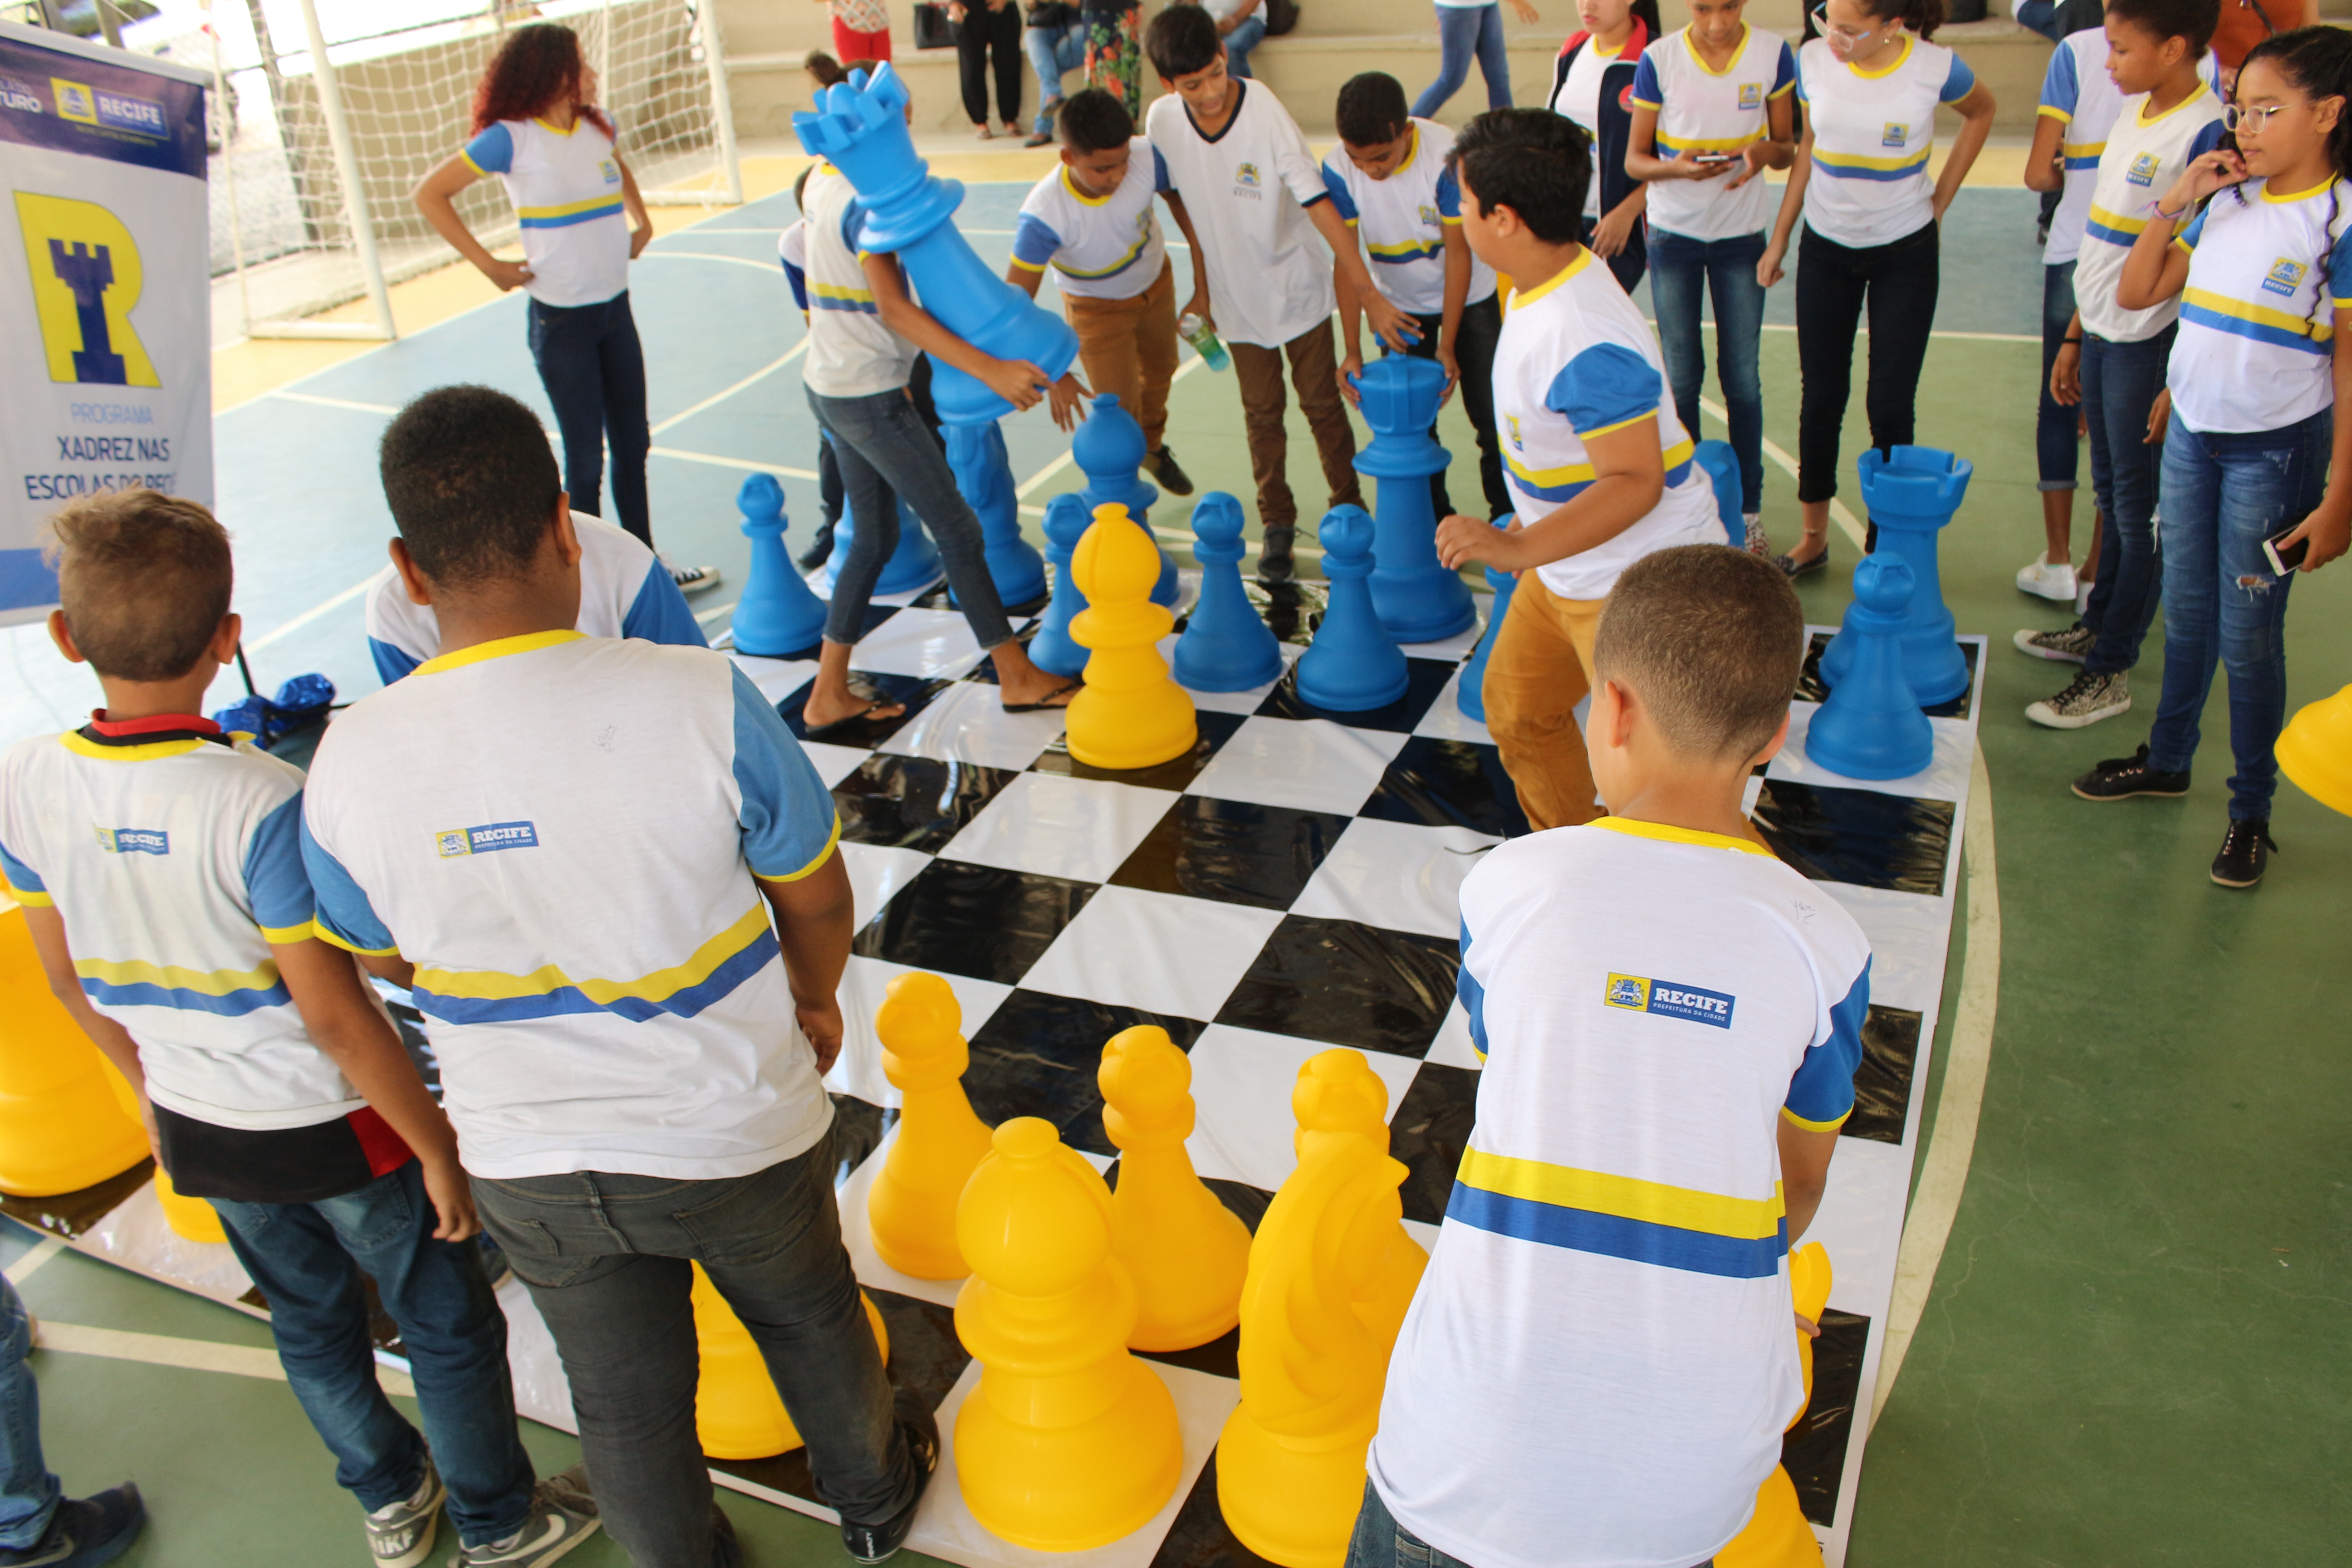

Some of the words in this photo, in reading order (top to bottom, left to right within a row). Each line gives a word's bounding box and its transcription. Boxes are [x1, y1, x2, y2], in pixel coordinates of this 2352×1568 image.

[98, 96, 161, 125] RECIFE
[2265, 280, 2293, 293] RECIFE
[70, 402, 154, 424] PROGRAMA
[57, 435, 135, 461] XADREZ
[137, 437, 170, 461] NAS
[24, 474, 116, 500] ESCOLAS
[472, 826, 532, 843] RECIFE
[1653, 1002, 1692, 1014] PREFEITURA
[1703, 1012, 1725, 1022] CIDADE
[1654, 987, 1729, 1015] RECIFE
